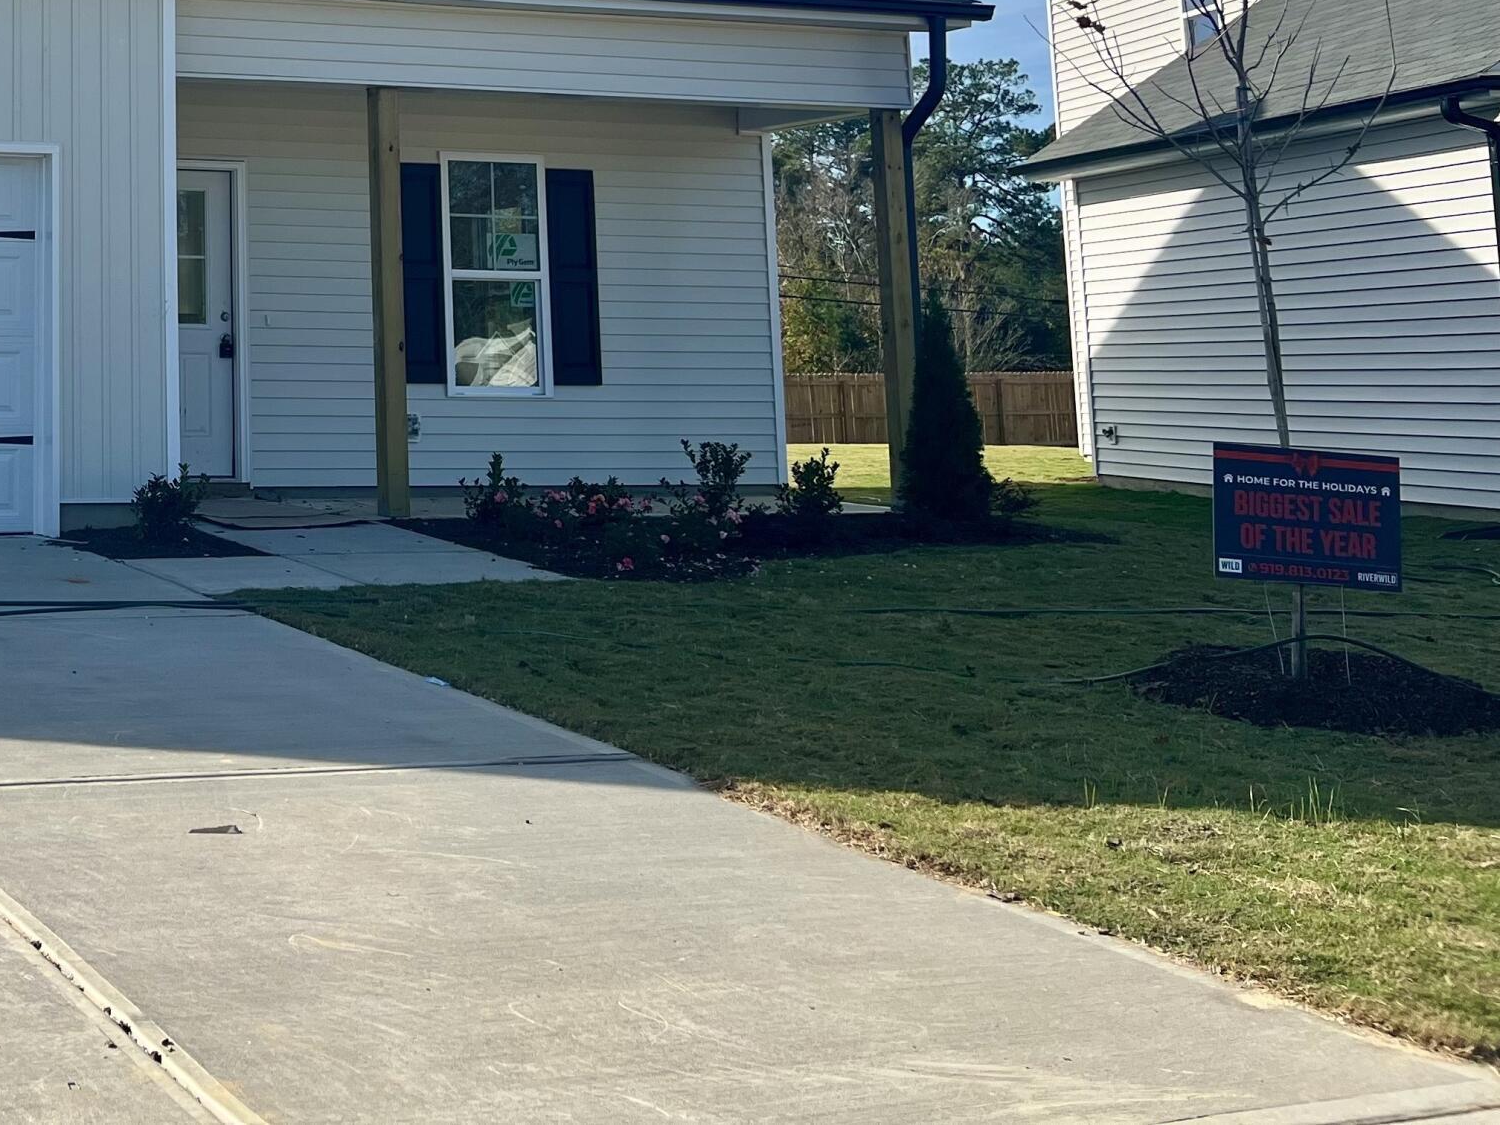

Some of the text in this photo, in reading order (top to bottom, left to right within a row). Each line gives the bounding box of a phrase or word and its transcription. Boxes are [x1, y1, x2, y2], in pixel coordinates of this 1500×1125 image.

[507, 258, 518, 266] Ply
[1236, 475, 1377, 495] HOME FOR THE HOLIDAYS
[1234, 489, 1382, 527] BIGGEST SALE
[1240, 522, 1377, 559] OF THE YEAR
[1221, 560, 1240, 571] WILD
[1258, 562, 1349, 581] 919.813.0123
[1357, 572, 1397, 585] RIVERWILD
